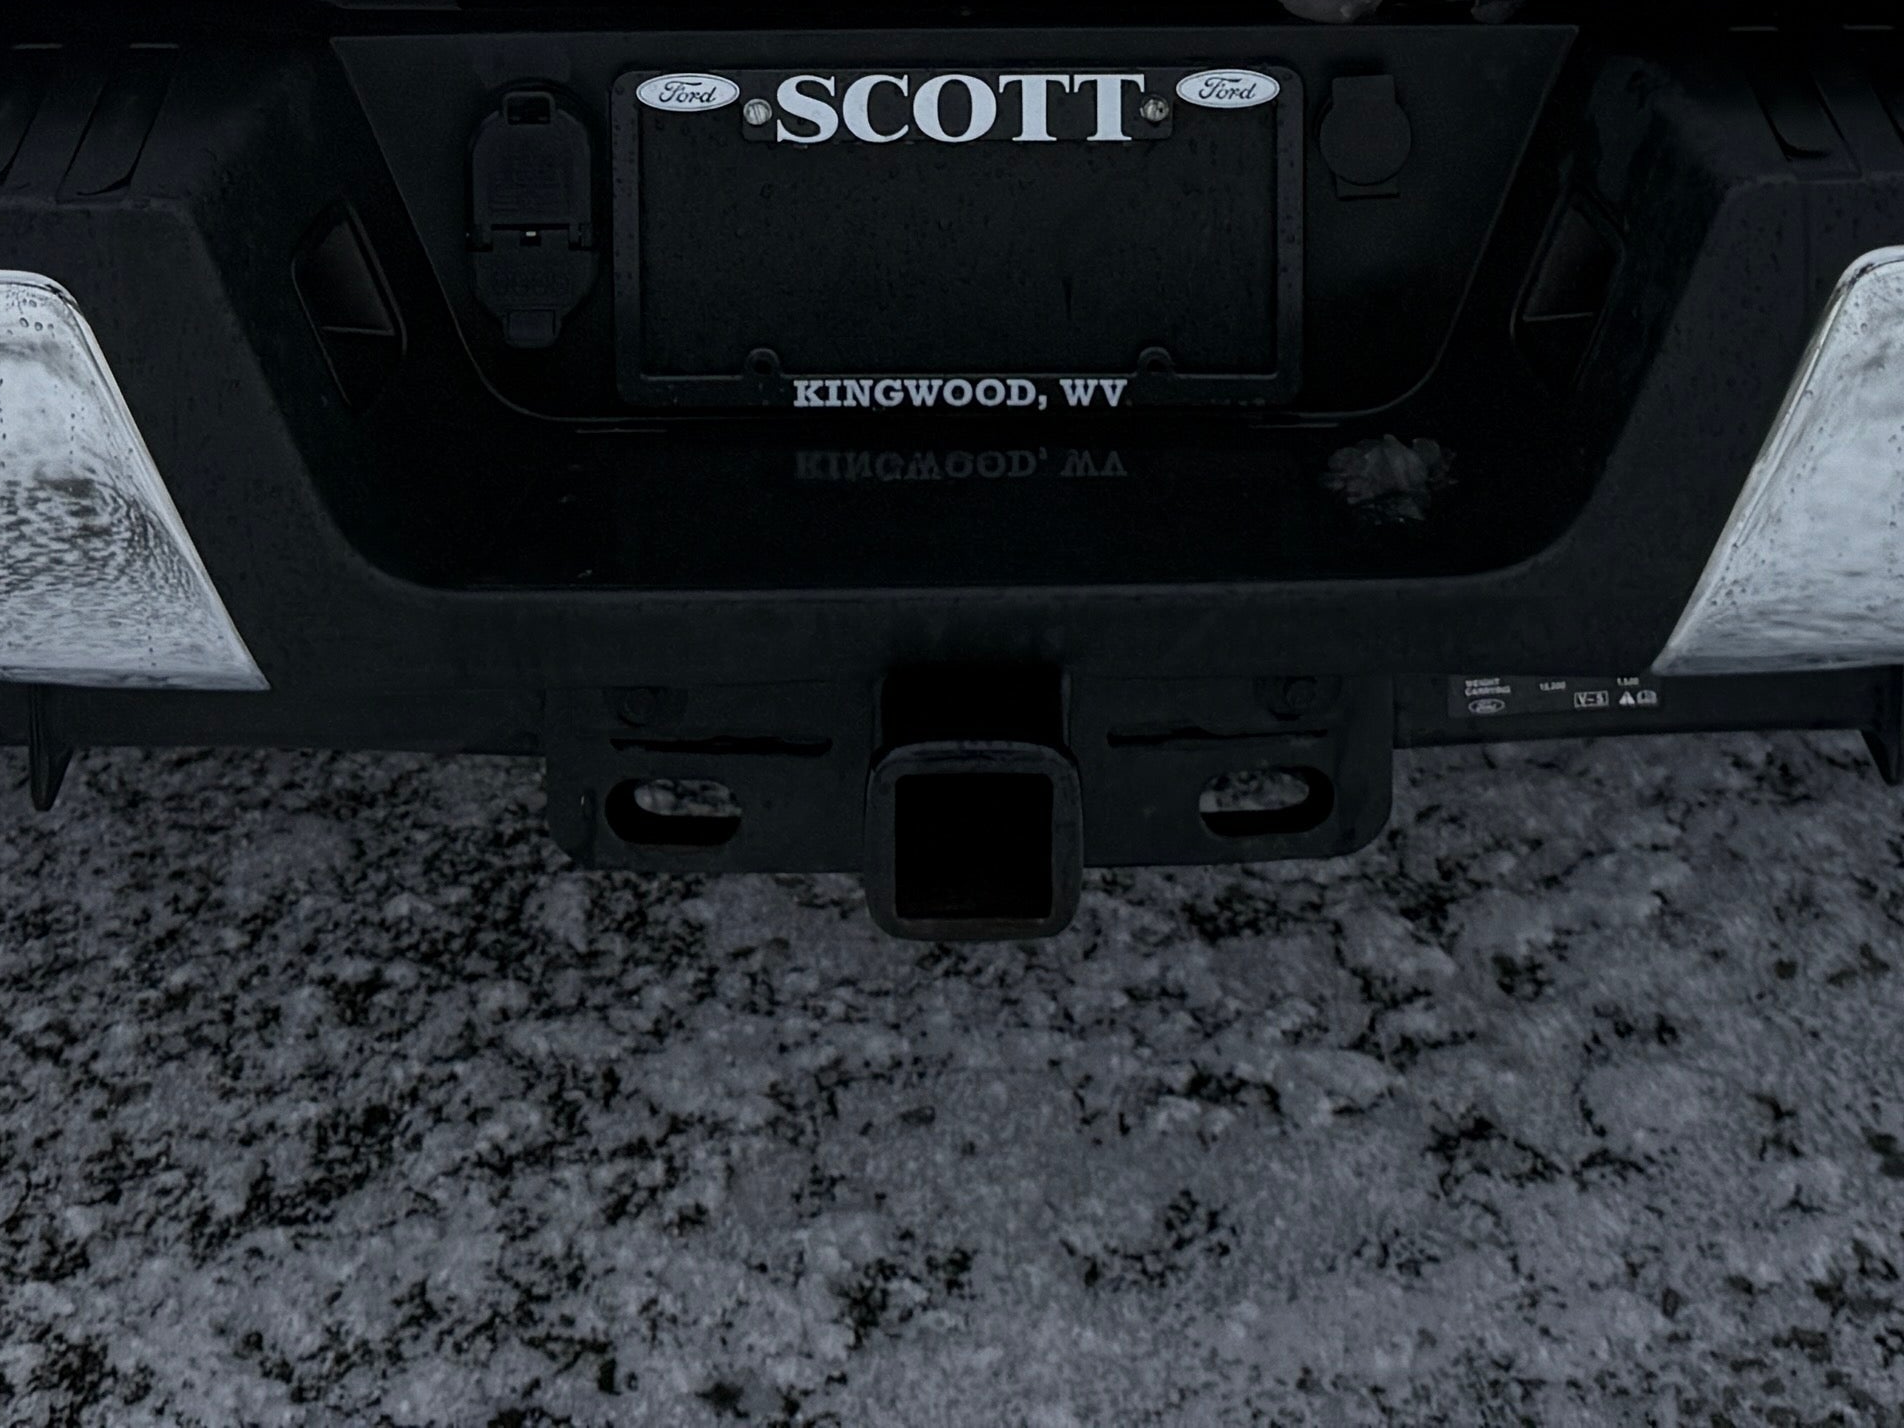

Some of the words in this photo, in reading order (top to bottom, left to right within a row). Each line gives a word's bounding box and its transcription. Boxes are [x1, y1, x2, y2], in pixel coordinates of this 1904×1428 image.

[659, 80, 717, 103] Ford
[1198, 76, 1257, 100] Ford
[775, 73, 1145, 143] SCOTT
[793, 378, 1048, 410] KINGWOOD,
[1058, 378, 1128, 407] WV
